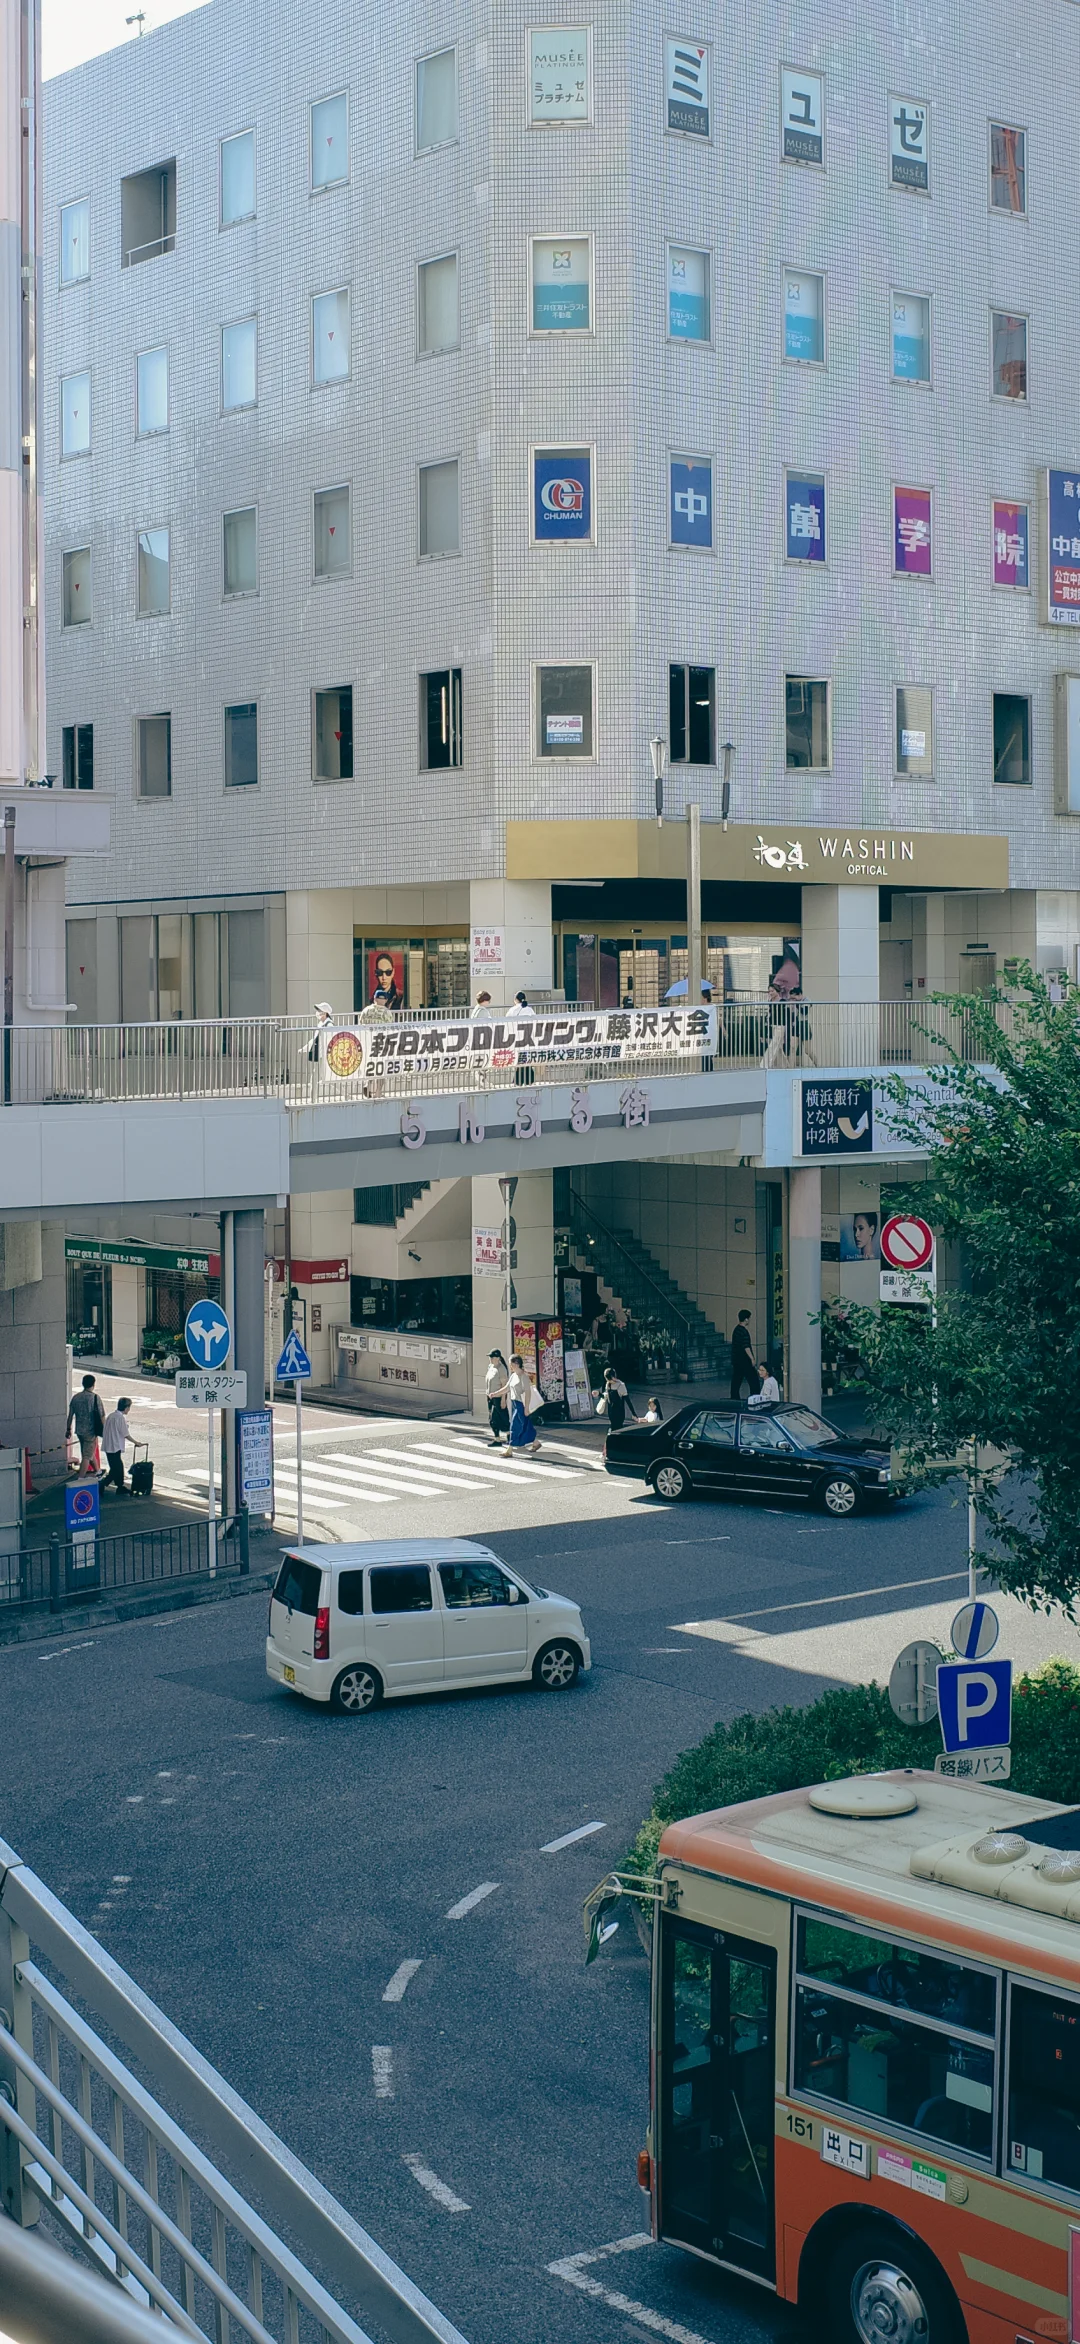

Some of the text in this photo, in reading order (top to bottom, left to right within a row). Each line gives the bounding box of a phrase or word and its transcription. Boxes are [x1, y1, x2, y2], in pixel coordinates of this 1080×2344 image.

[534, 93, 585, 104] プラチナム
[672, 50, 703, 102] ミ
[893, 108, 925, 154] ゼ
[537, 304, 587, 312] 三井住友トラスト
[552, 311, 572, 319] 不動産
[543, 512, 583, 520] CHUMAN
[674, 488, 1025, 566] 中 萬 学 院
[1052, 608, 1064, 622] 4F
[547, 720, 581, 728] テナント
[818, 837, 914, 860] WASHIN
[848, 864, 888, 875] OPTICAL
[474, 936, 500, 946] 英会話
[480, 948, 495, 958] MLS
[369, 1010, 710, 1058] 新日本プロレスリング 藤沢大会
[517, 1045, 621, 1065] 藤沢市秩父宮記念体育館
[806, 1088, 860, 1106] 横浜銀行
[914, 1085, 955, 1103] Dental
[400, 1087, 650, 1150] らんぶる街
[806, 1109, 834, 1125] となり
[806, 1128, 839, 1145] 中2階
[476, 1237, 502, 1248] 英会話
[482, 1249, 497, 1259] MLS
[340, 1335, 357, 1344] coffee
[179, 1376, 244, 1389] 路線バス・タクシー
[381, 1366, 417, 1383] 地下飲食街
[191, 1390, 232, 1403] を除く
[957, 1671, 998, 1742] P
[940, 1756, 1006, 1777] 路線バス
[786, 2114, 813, 2141] 151
[827, 2131, 863, 2162] 出口
[833, 2153, 855, 2169] EXIT
[918, 2164, 939, 2179] Suica
